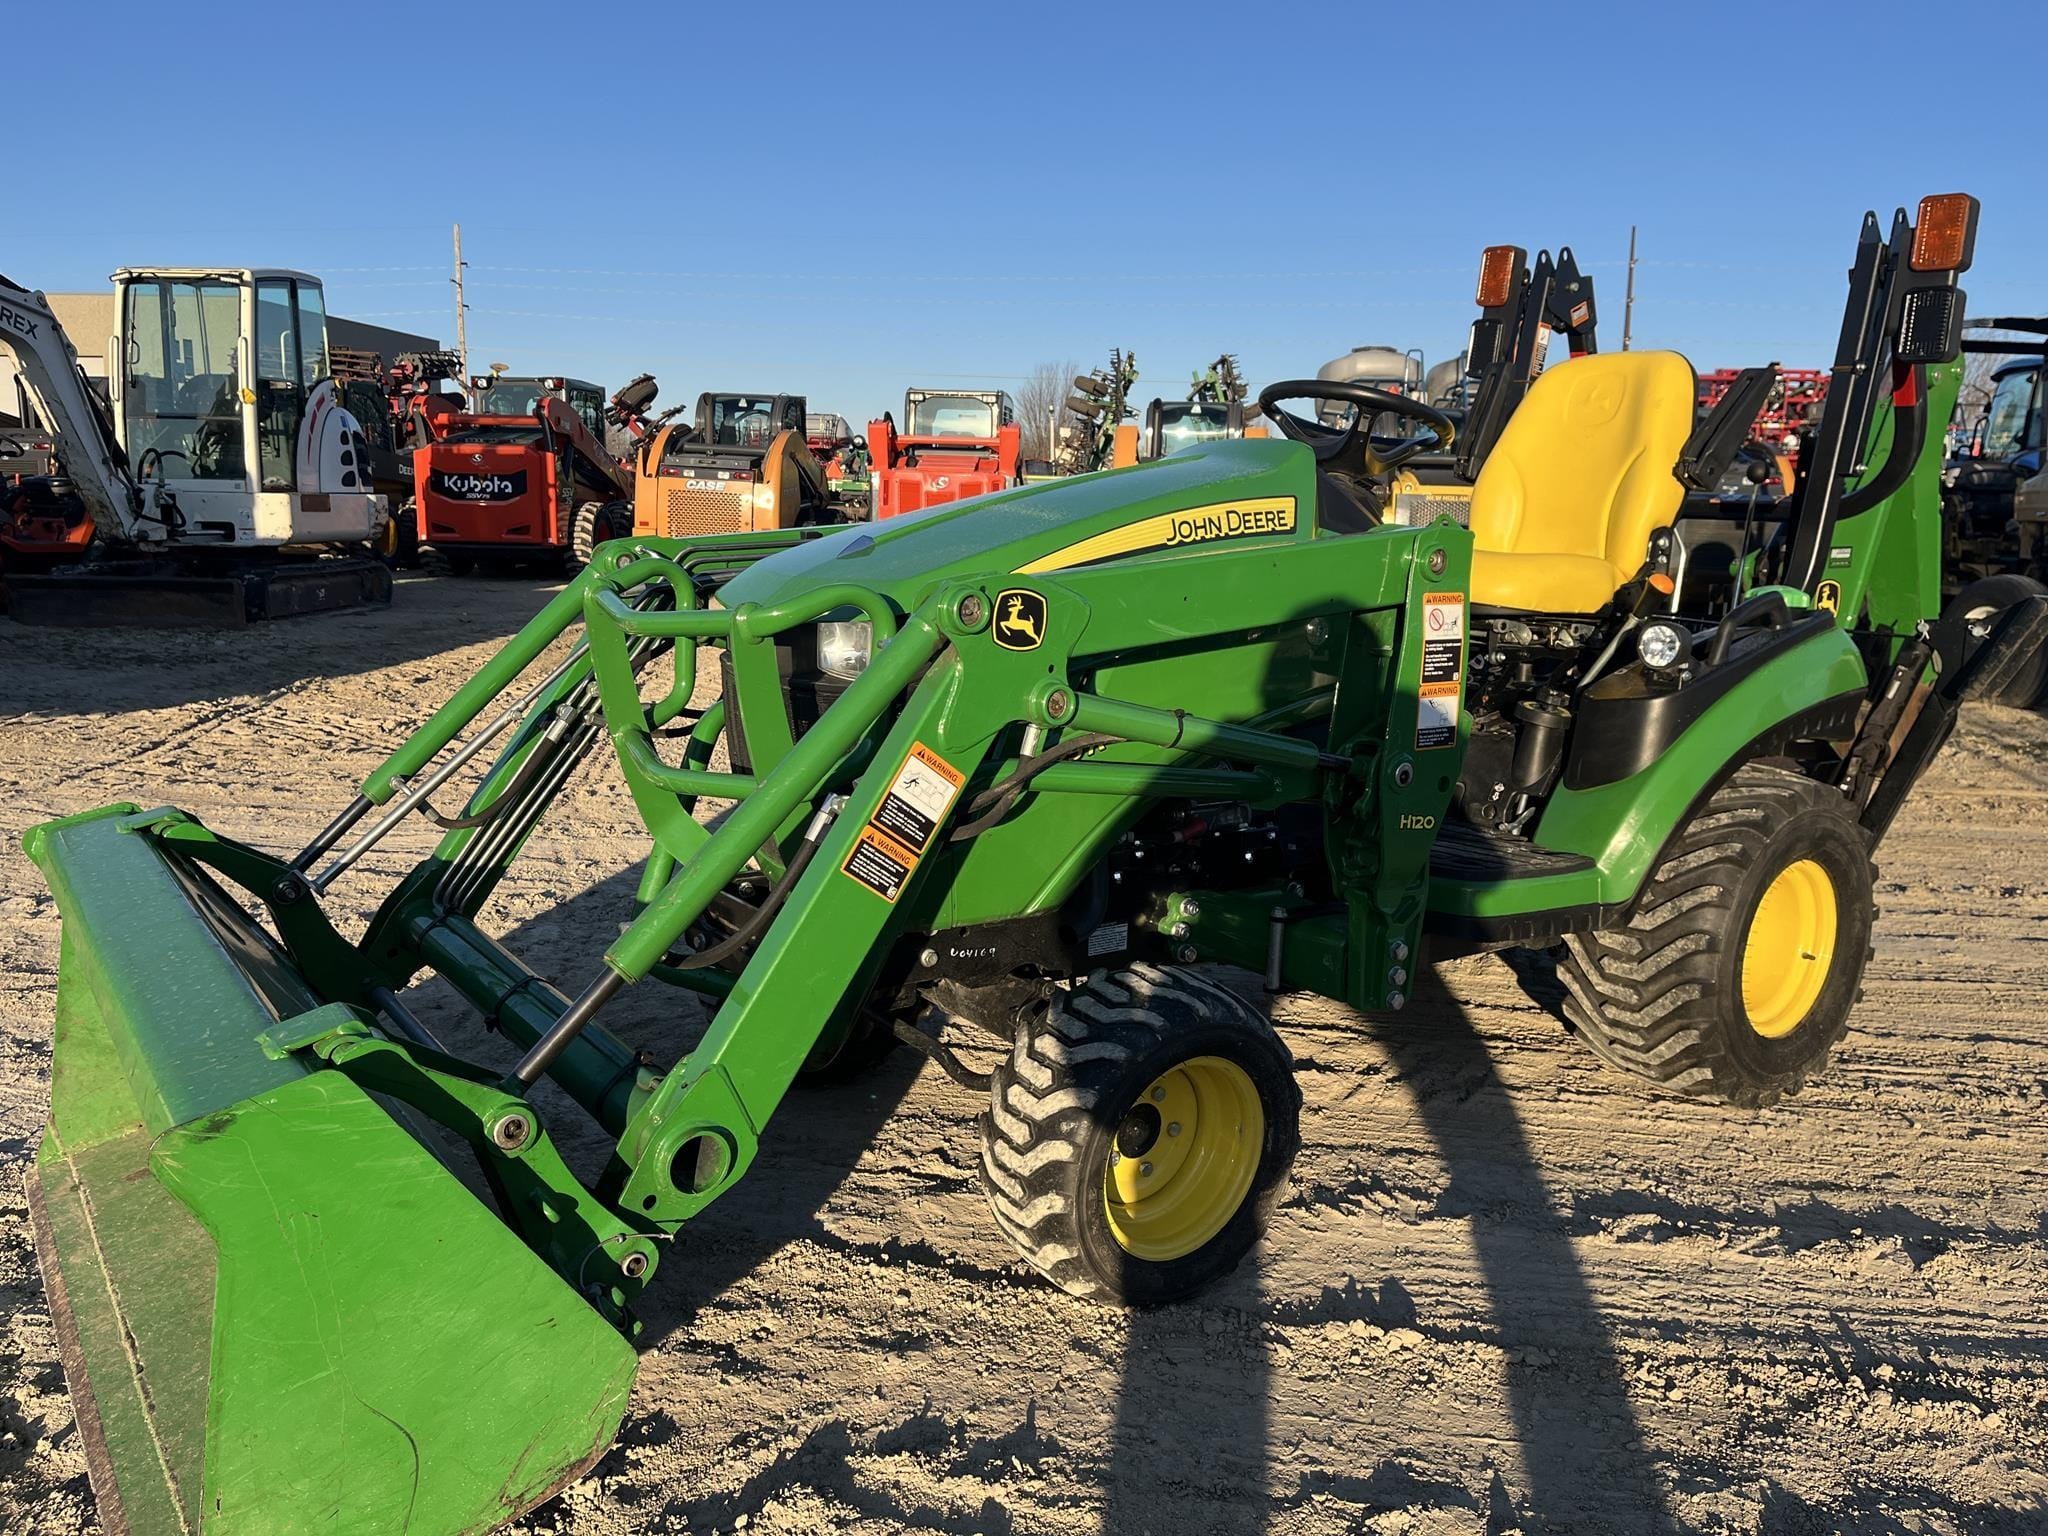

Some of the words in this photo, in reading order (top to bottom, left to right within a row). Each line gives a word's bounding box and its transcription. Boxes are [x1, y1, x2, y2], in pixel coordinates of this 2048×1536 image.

[444, 475, 513, 493] Kubota
[686, 479, 726, 491] CASE
[1166, 518, 1223, 542] JOHN
[1226, 510, 1288, 532] DEERE
[1431, 594, 1462, 604] WARNING
[1427, 686, 1458, 696] WARNING
[926, 754, 959, 782] WARNING
[1400, 814, 1435, 829] H120
[878, 839, 911, 865] WARNING
